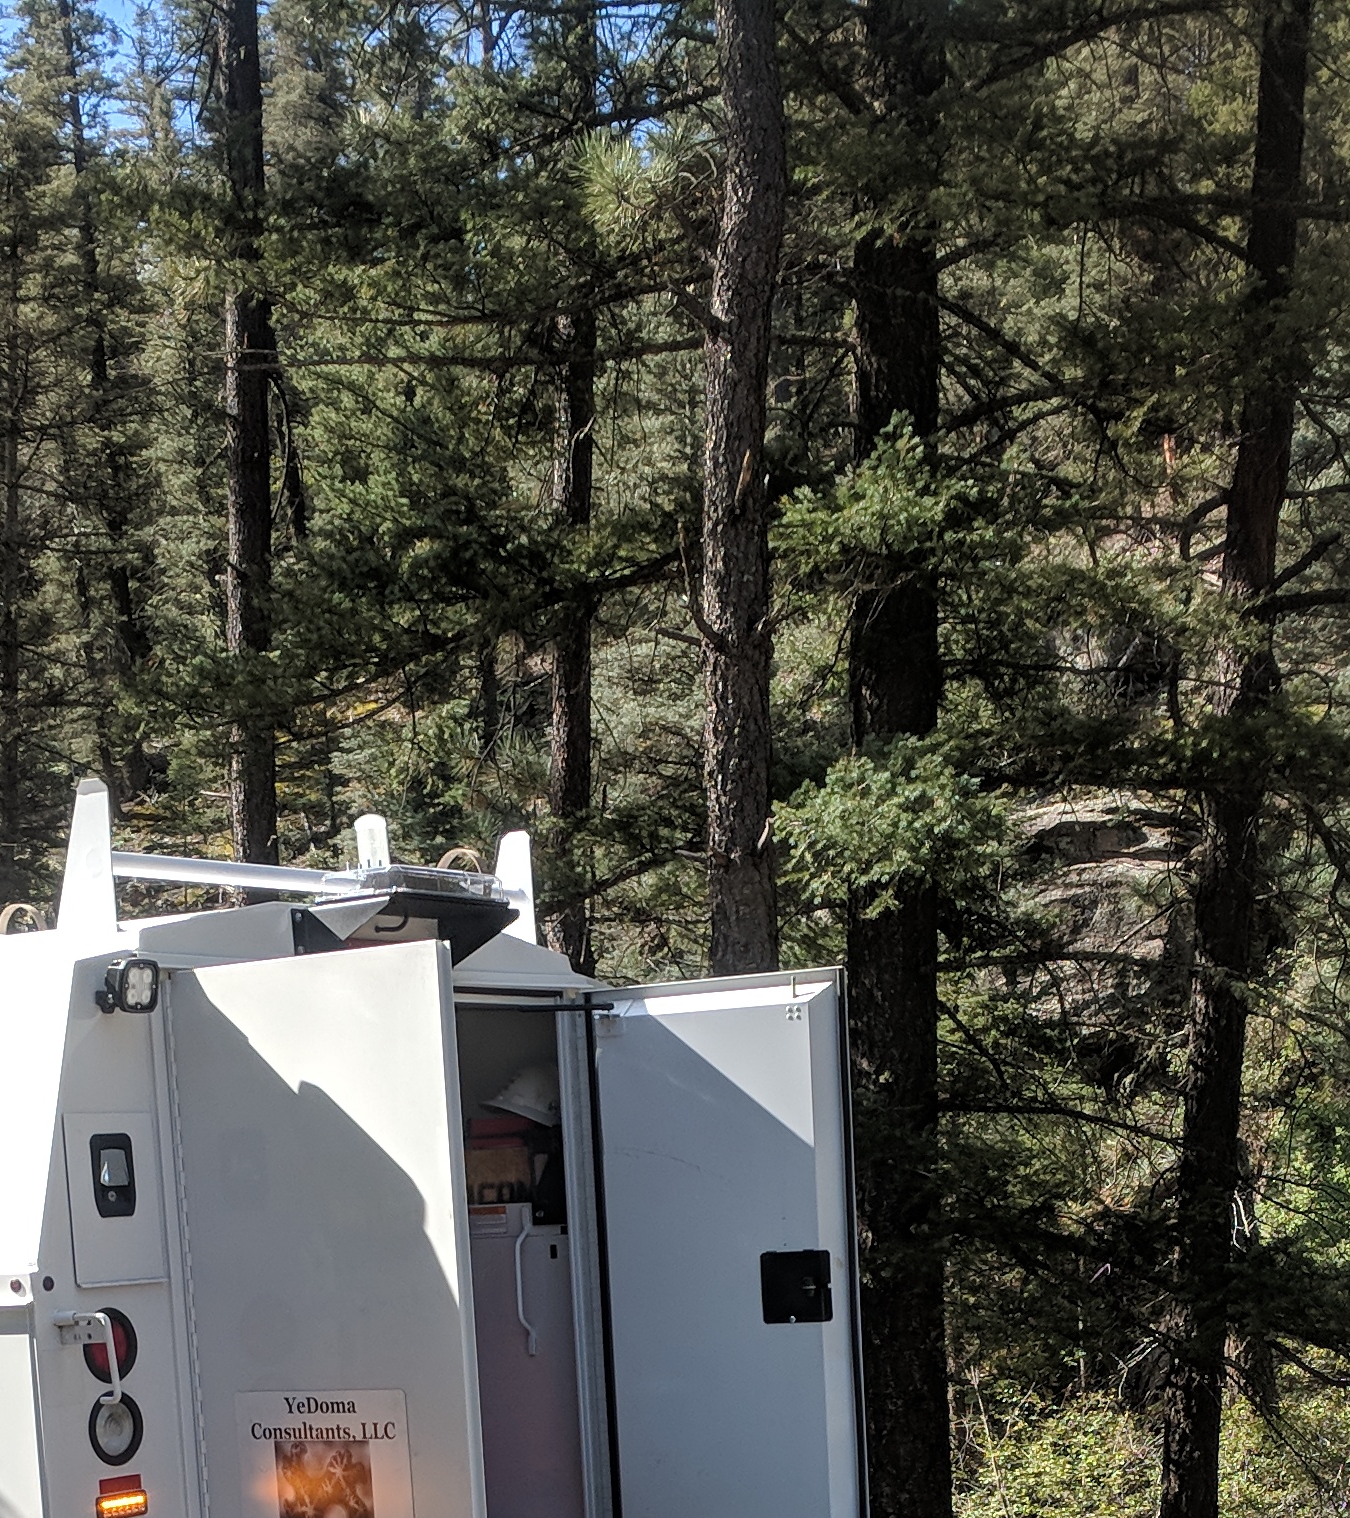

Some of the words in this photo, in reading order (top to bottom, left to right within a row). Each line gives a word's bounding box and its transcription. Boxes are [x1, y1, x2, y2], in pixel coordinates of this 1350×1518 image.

[283, 1396, 358, 1415] YeDoma
[251, 1421, 357, 1441] Consultants,
[360, 1421, 397, 1440] LLC
